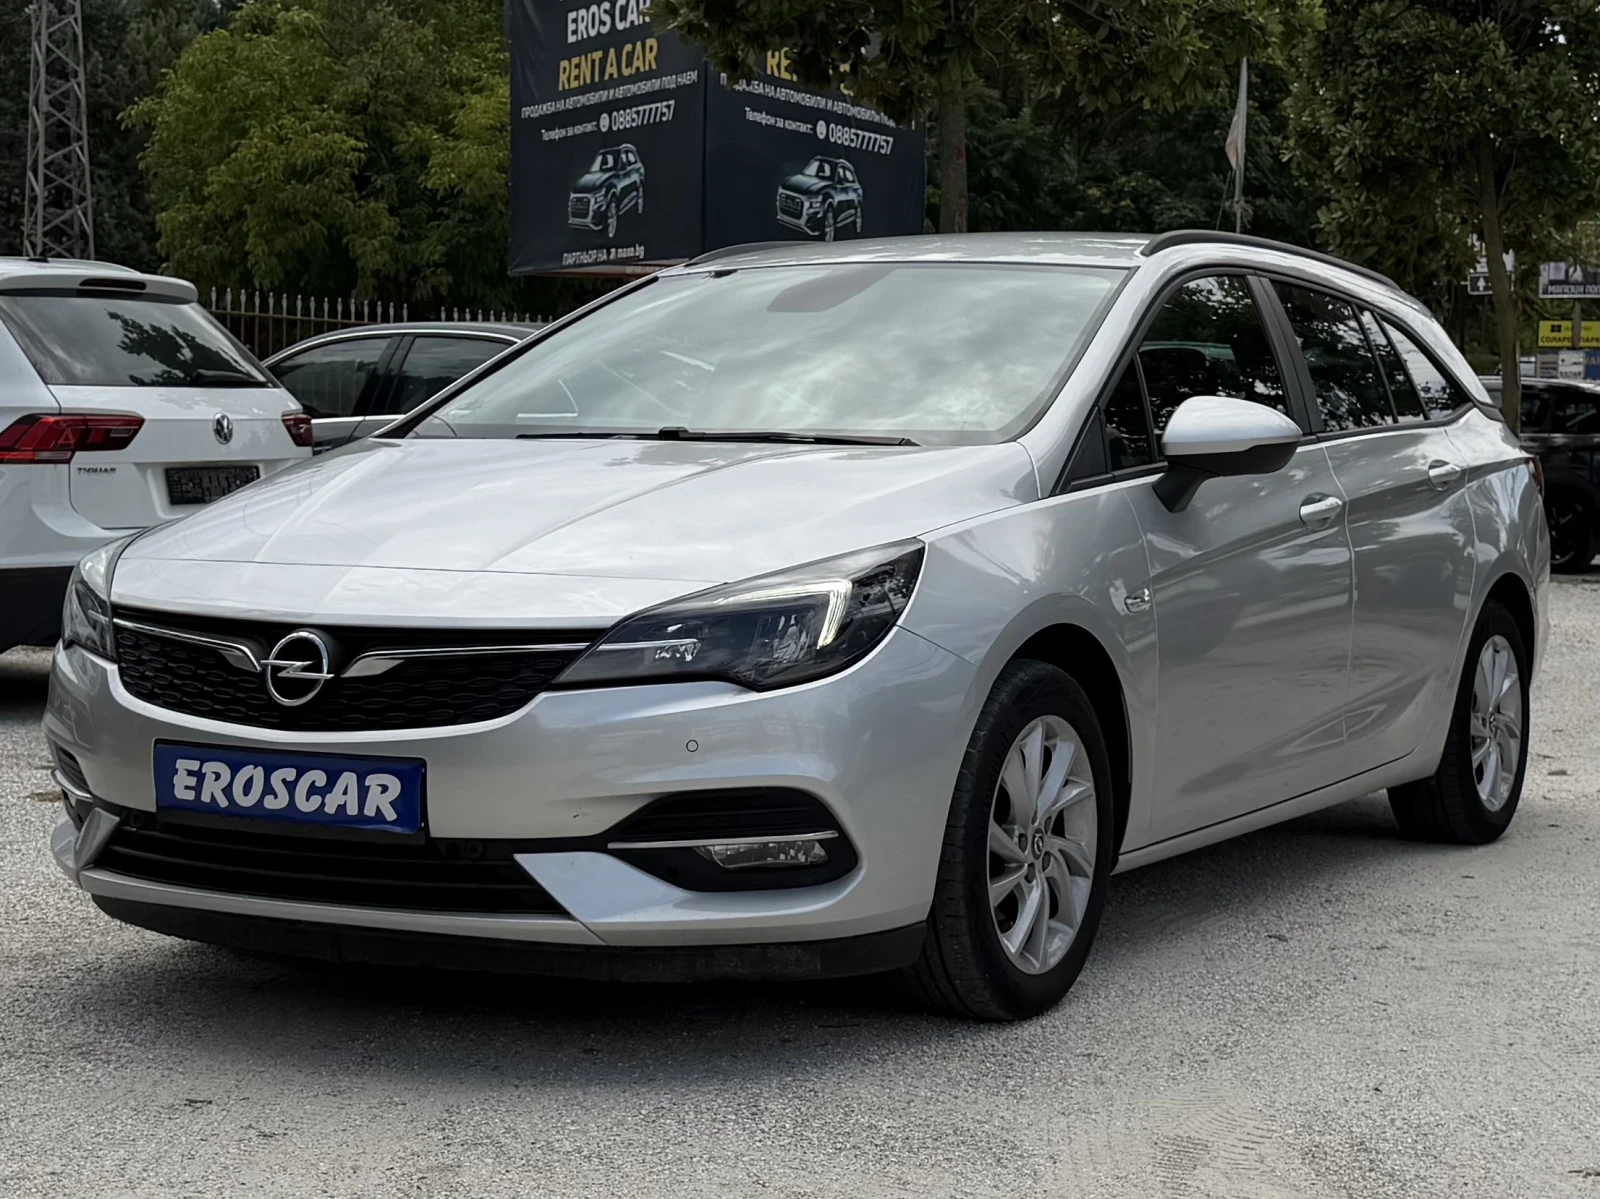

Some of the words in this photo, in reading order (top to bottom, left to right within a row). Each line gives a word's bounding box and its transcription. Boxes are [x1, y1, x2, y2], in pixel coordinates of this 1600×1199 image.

[567, 1, 611, 43] EROS
[558, 50, 603, 91] RENT
[604, 47, 618, 80] A
[621, 38, 658, 76] CAR
[521, 101, 555, 118] ПРОДАЖБА
[565, 90, 608, 110] АВТОМОБИЛИ
[615, 79, 661, 98] АВТОМОБИЛИ
[661, 74, 676, 90] ПОД
[677, 70, 698, 87] НАЕМ
[775, 87, 826, 110] АВТОМОБИЛИ
[541, 127, 567, 141] Телефон
[611, 99, 675, 131] 0885777757
[744, 106, 776, 126] Телефон
[829, 123, 894, 154] 0885777757
[173, 759, 401, 821] EROSCAR
